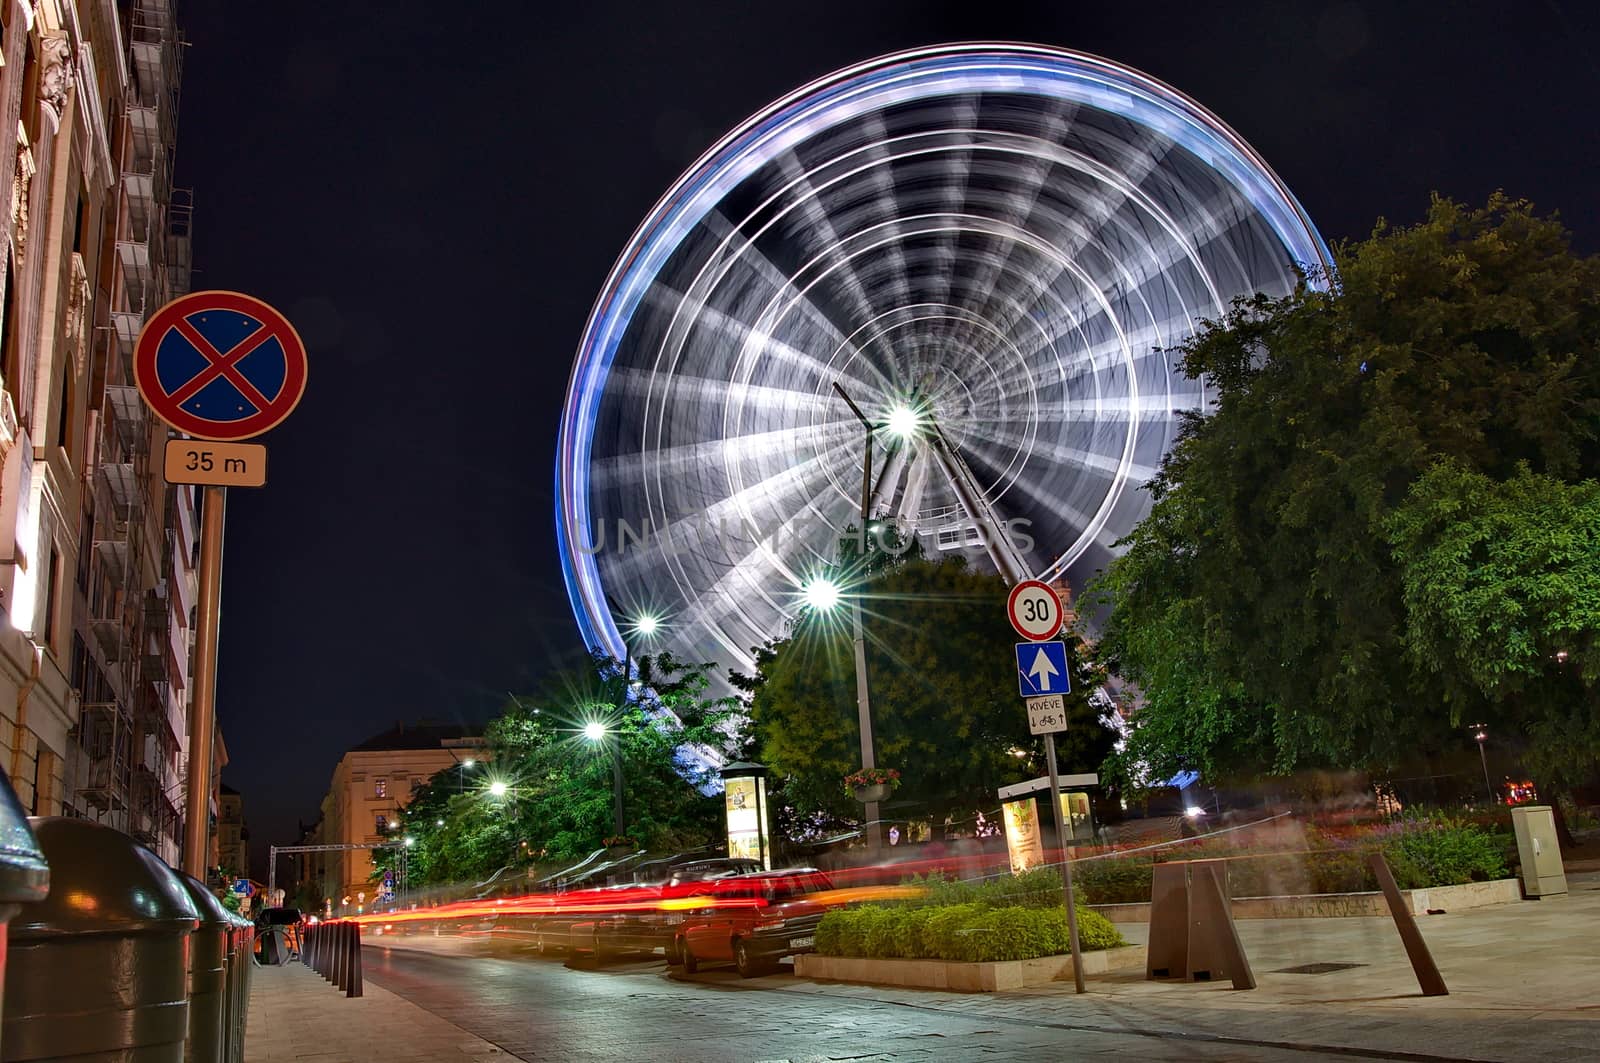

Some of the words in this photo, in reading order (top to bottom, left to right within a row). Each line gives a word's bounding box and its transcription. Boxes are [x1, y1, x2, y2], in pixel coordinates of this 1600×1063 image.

[186, 451, 213, 472] 35
[224, 458, 247, 473] m
[1023, 598, 1050, 622] 30
[1030, 699, 1061, 711] KIVÉVE
